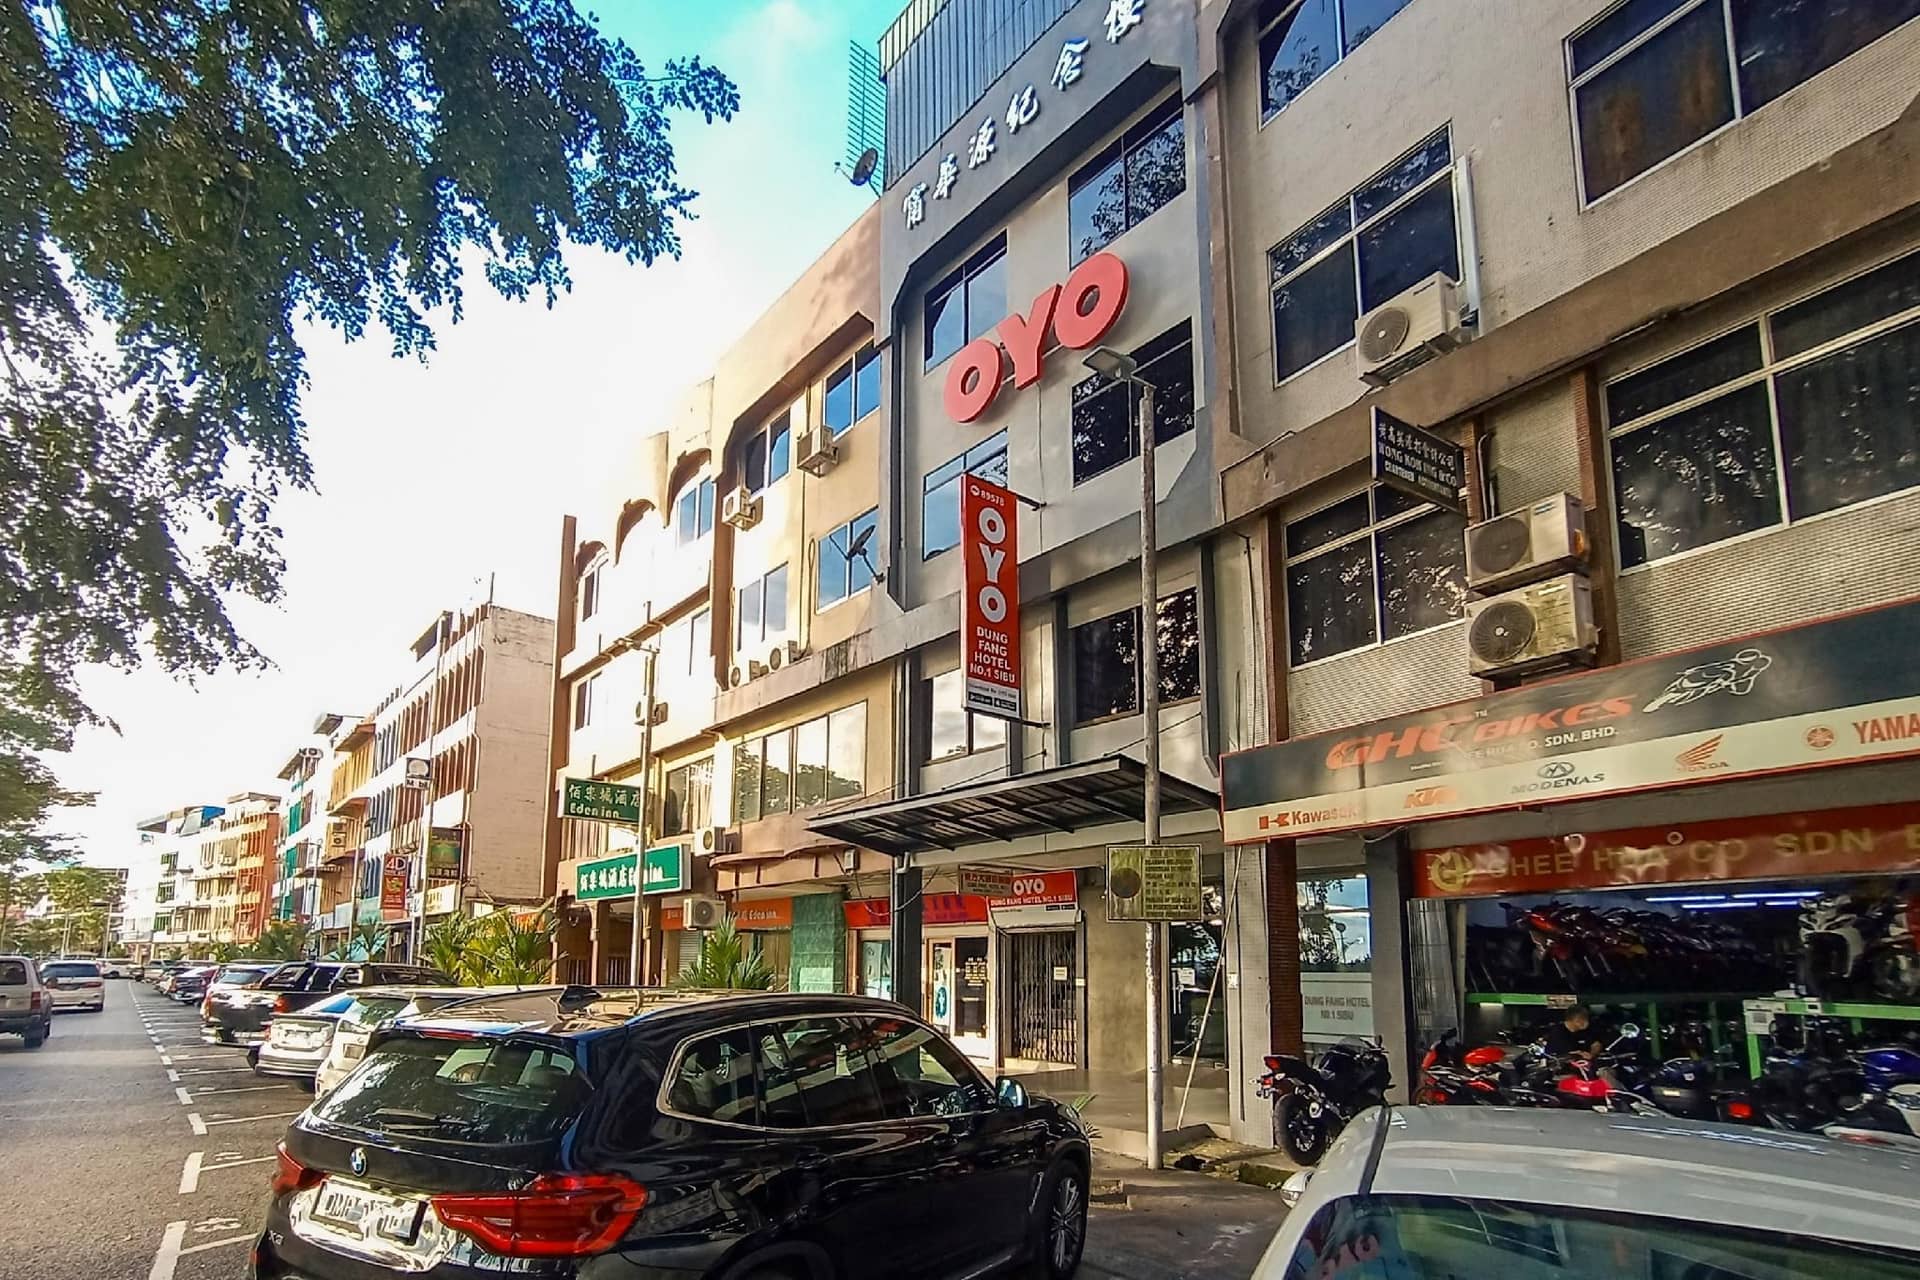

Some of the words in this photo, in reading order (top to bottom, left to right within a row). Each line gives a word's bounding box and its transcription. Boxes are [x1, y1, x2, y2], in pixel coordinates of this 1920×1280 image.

[943, 252, 1129, 424] OYO
[978, 507, 1006, 623] OYO
[976, 626, 1008, 644] DUNG
[979, 640, 1008, 657] FANG
[974, 651, 1011, 670] HOTEL
[1545, 732, 1579, 747] SDN.
[1581, 726, 1619, 741] BHD.
[570, 802, 598, 816] Eden
[1775, 827, 1874, 857] SDN
[1013, 878, 1045, 896] OYO
